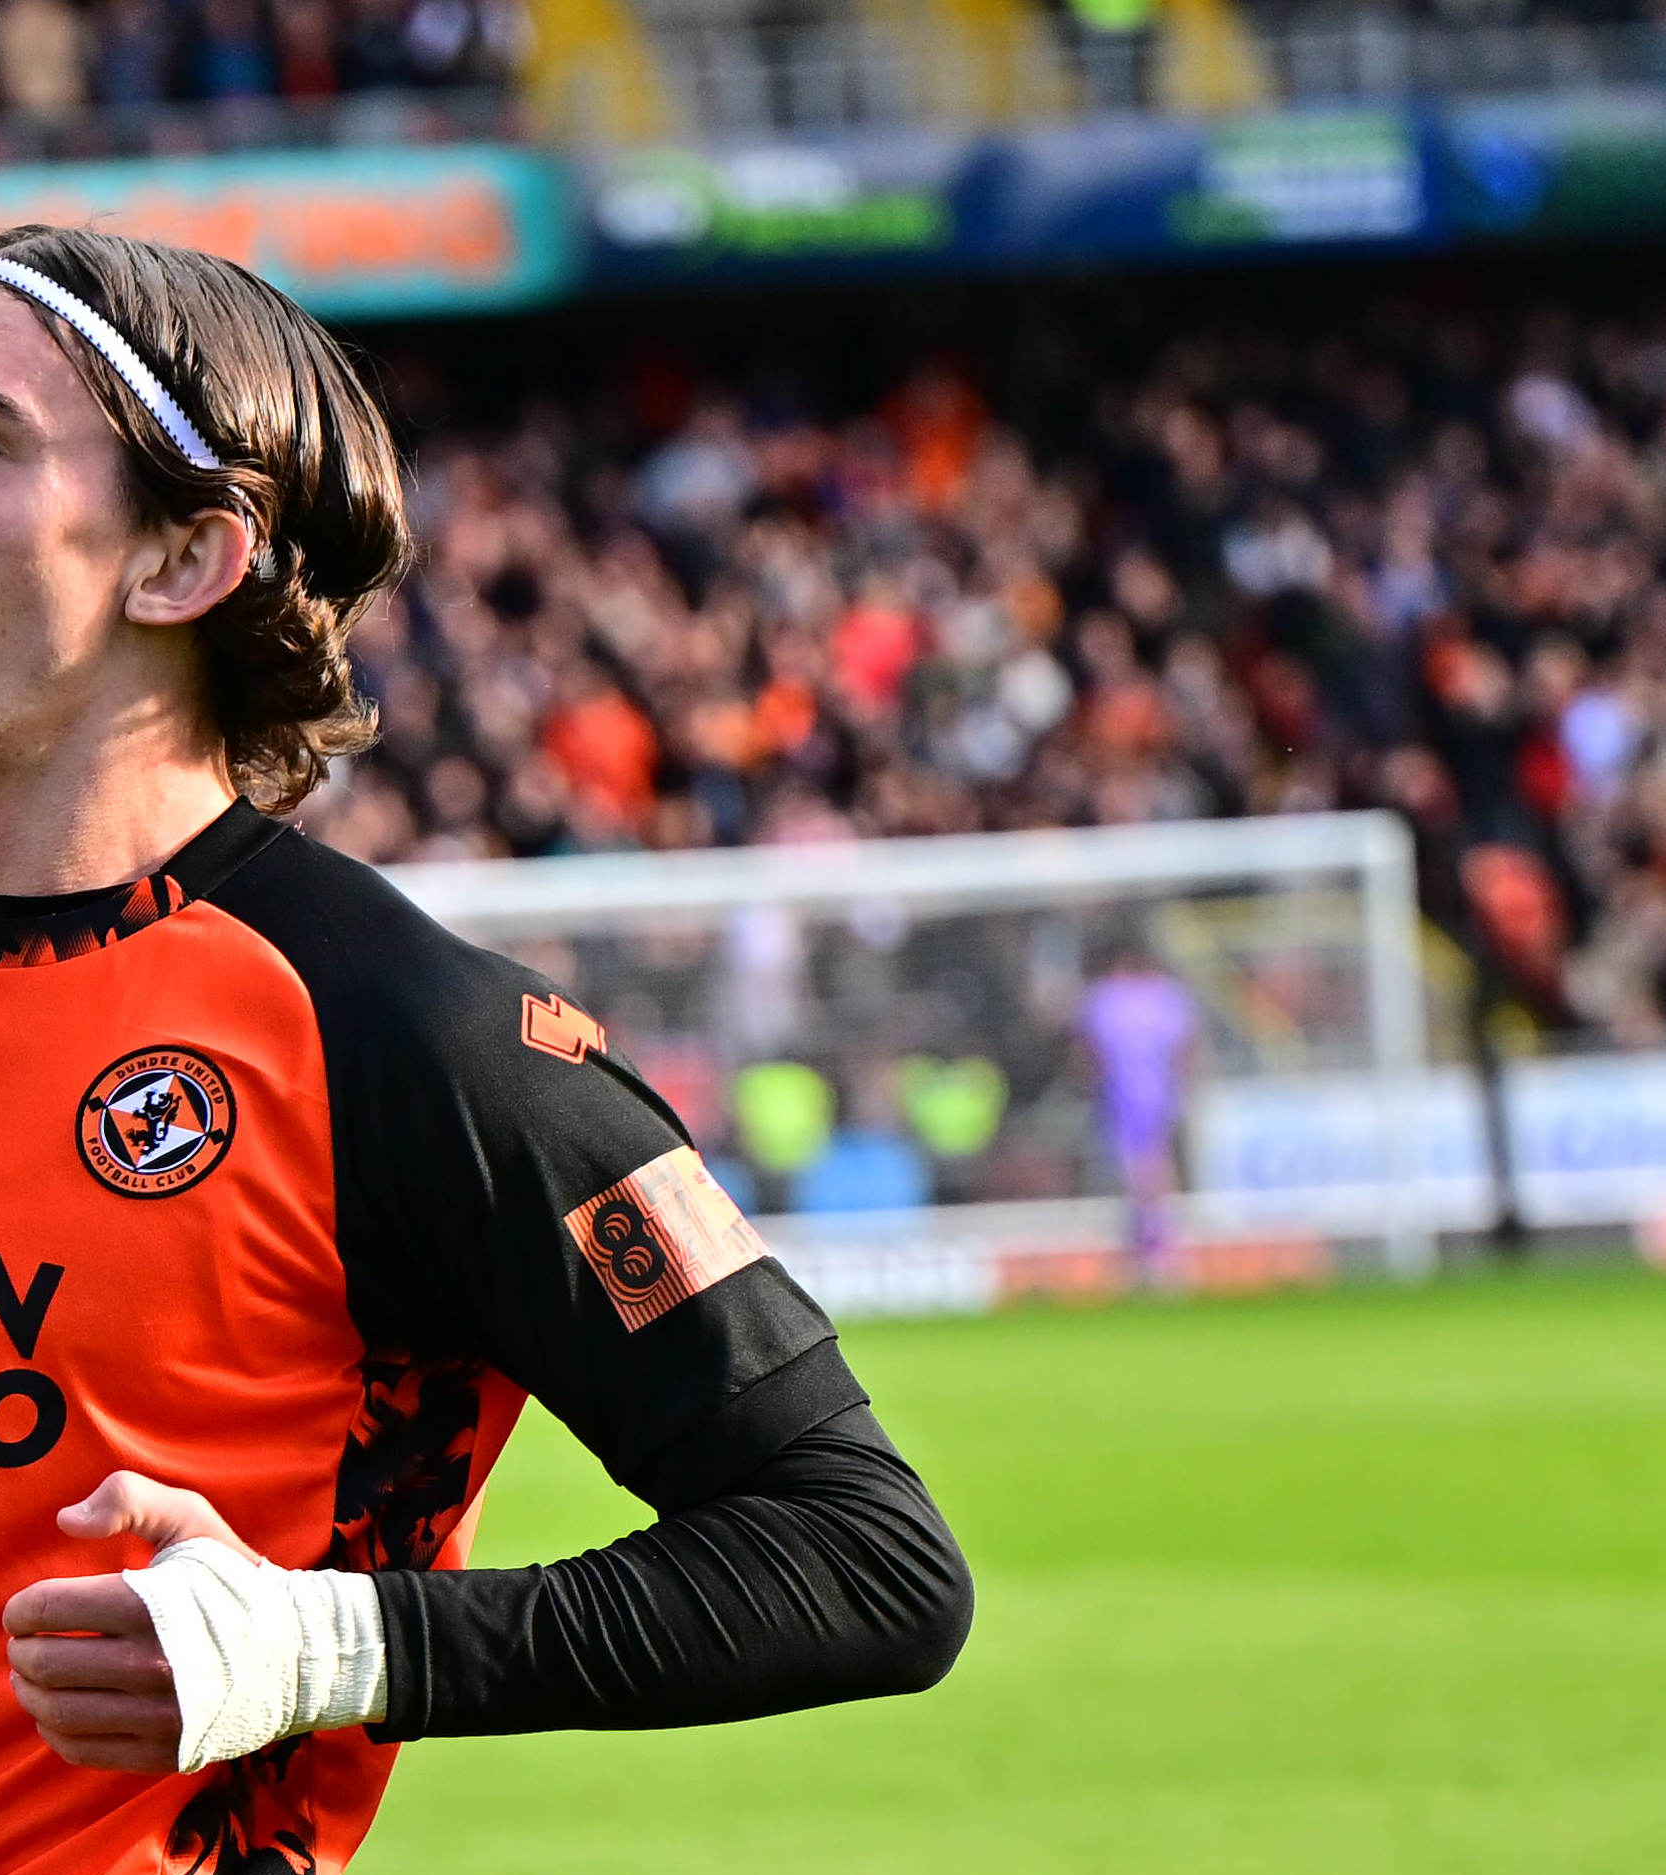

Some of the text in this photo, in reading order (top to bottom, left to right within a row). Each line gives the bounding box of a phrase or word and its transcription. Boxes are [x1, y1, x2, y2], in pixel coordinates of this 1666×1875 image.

[116, 1056, 224, 1105] DUNDEE UNITED
[87, 1137, 197, 1188] FOOTBALL CLUB
